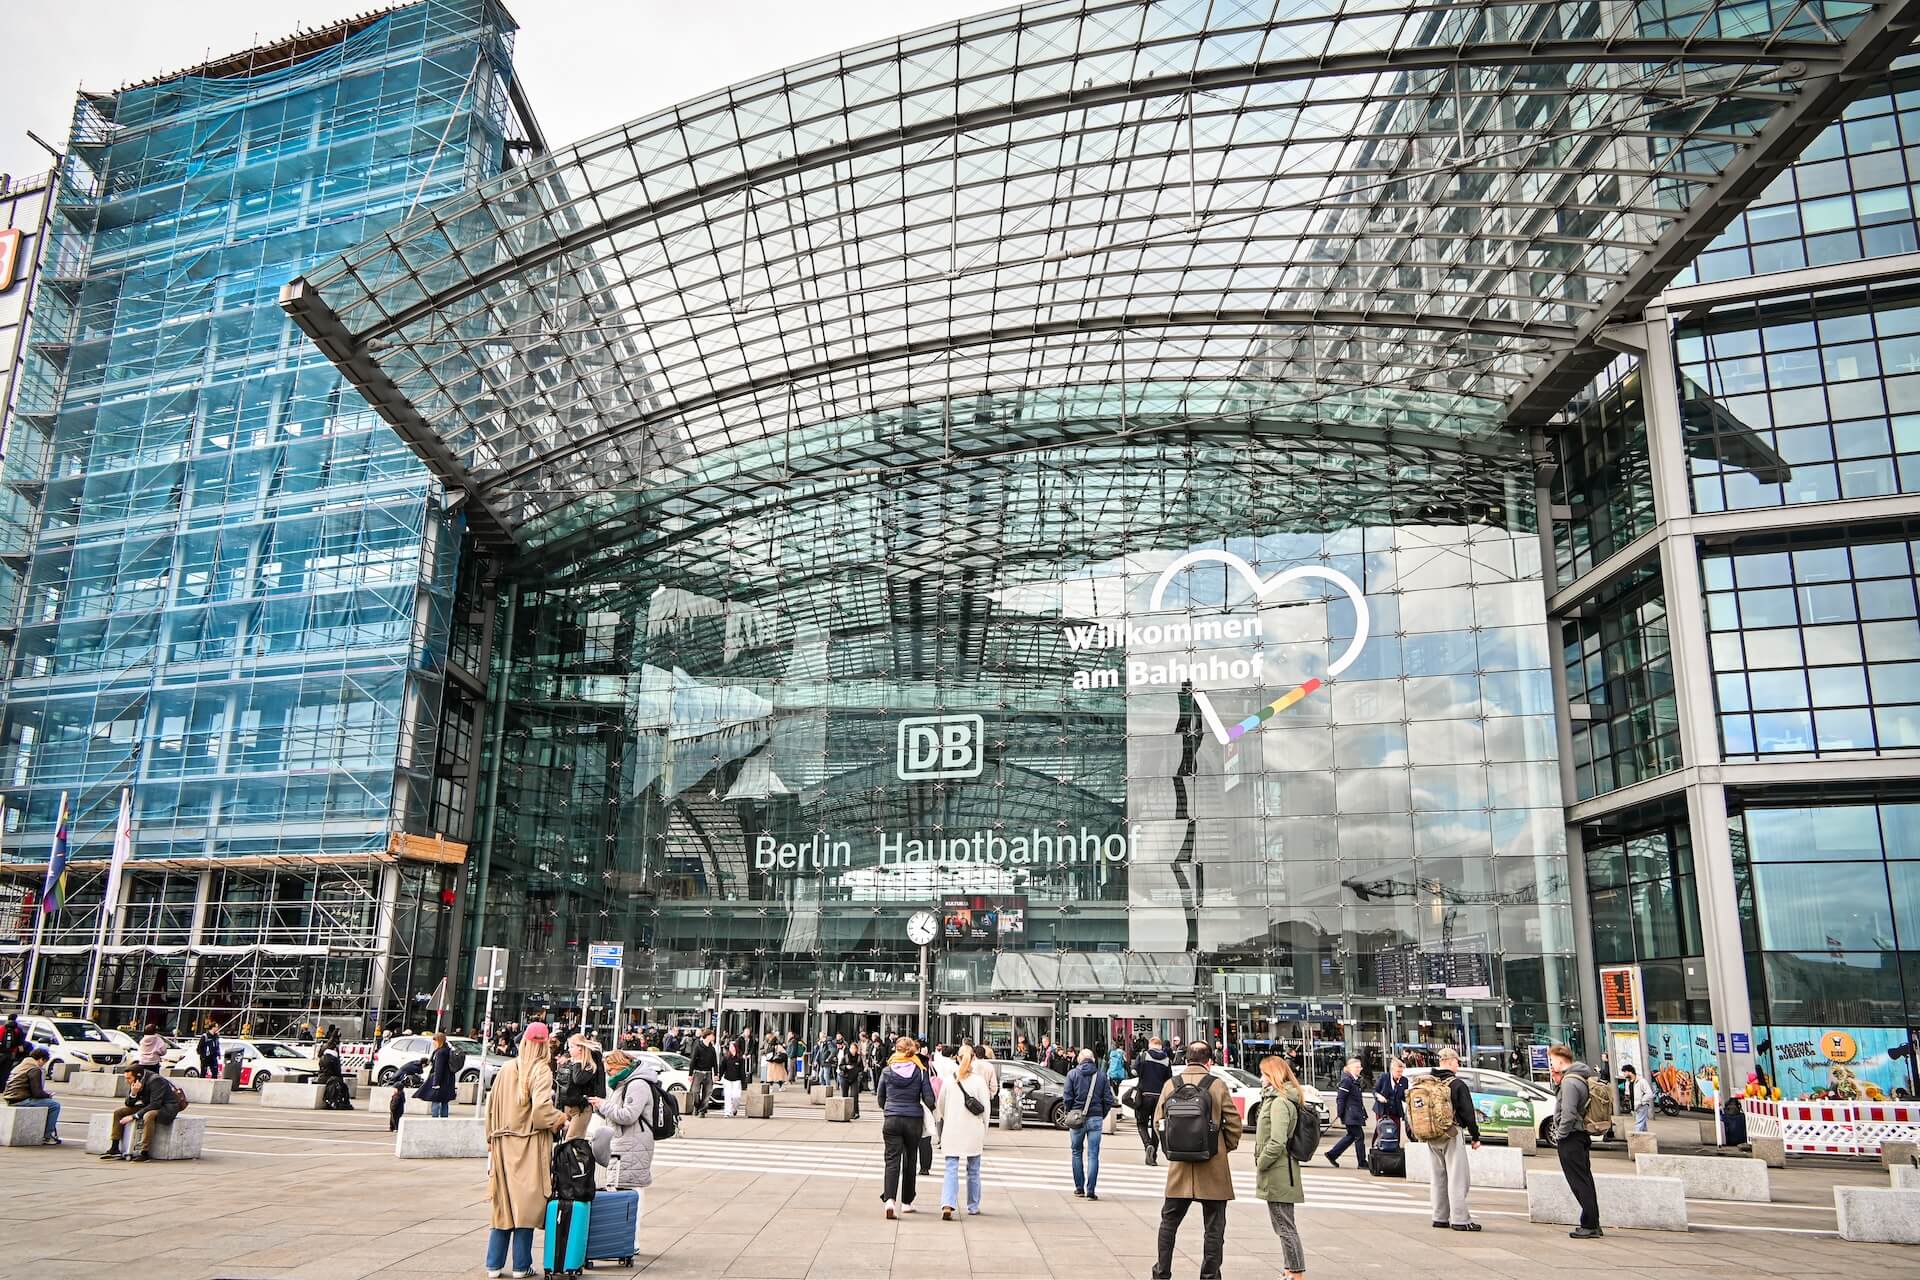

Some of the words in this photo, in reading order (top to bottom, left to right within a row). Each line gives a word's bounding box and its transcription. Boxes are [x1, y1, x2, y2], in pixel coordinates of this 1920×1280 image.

[1064, 617, 1263, 649] Willkommen
[1073, 668, 1119, 690] am
[1128, 652, 1264, 686] Bahnhof
[908, 724, 973, 770] DB
[755, 834, 851, 869] Berlin
[879, 824, 1142, 874] Hauptbahnhof
[1775, 1040, 1814, 1051] SEASONAL
[1778, 1050, 1817, 1061] BURRITOS
